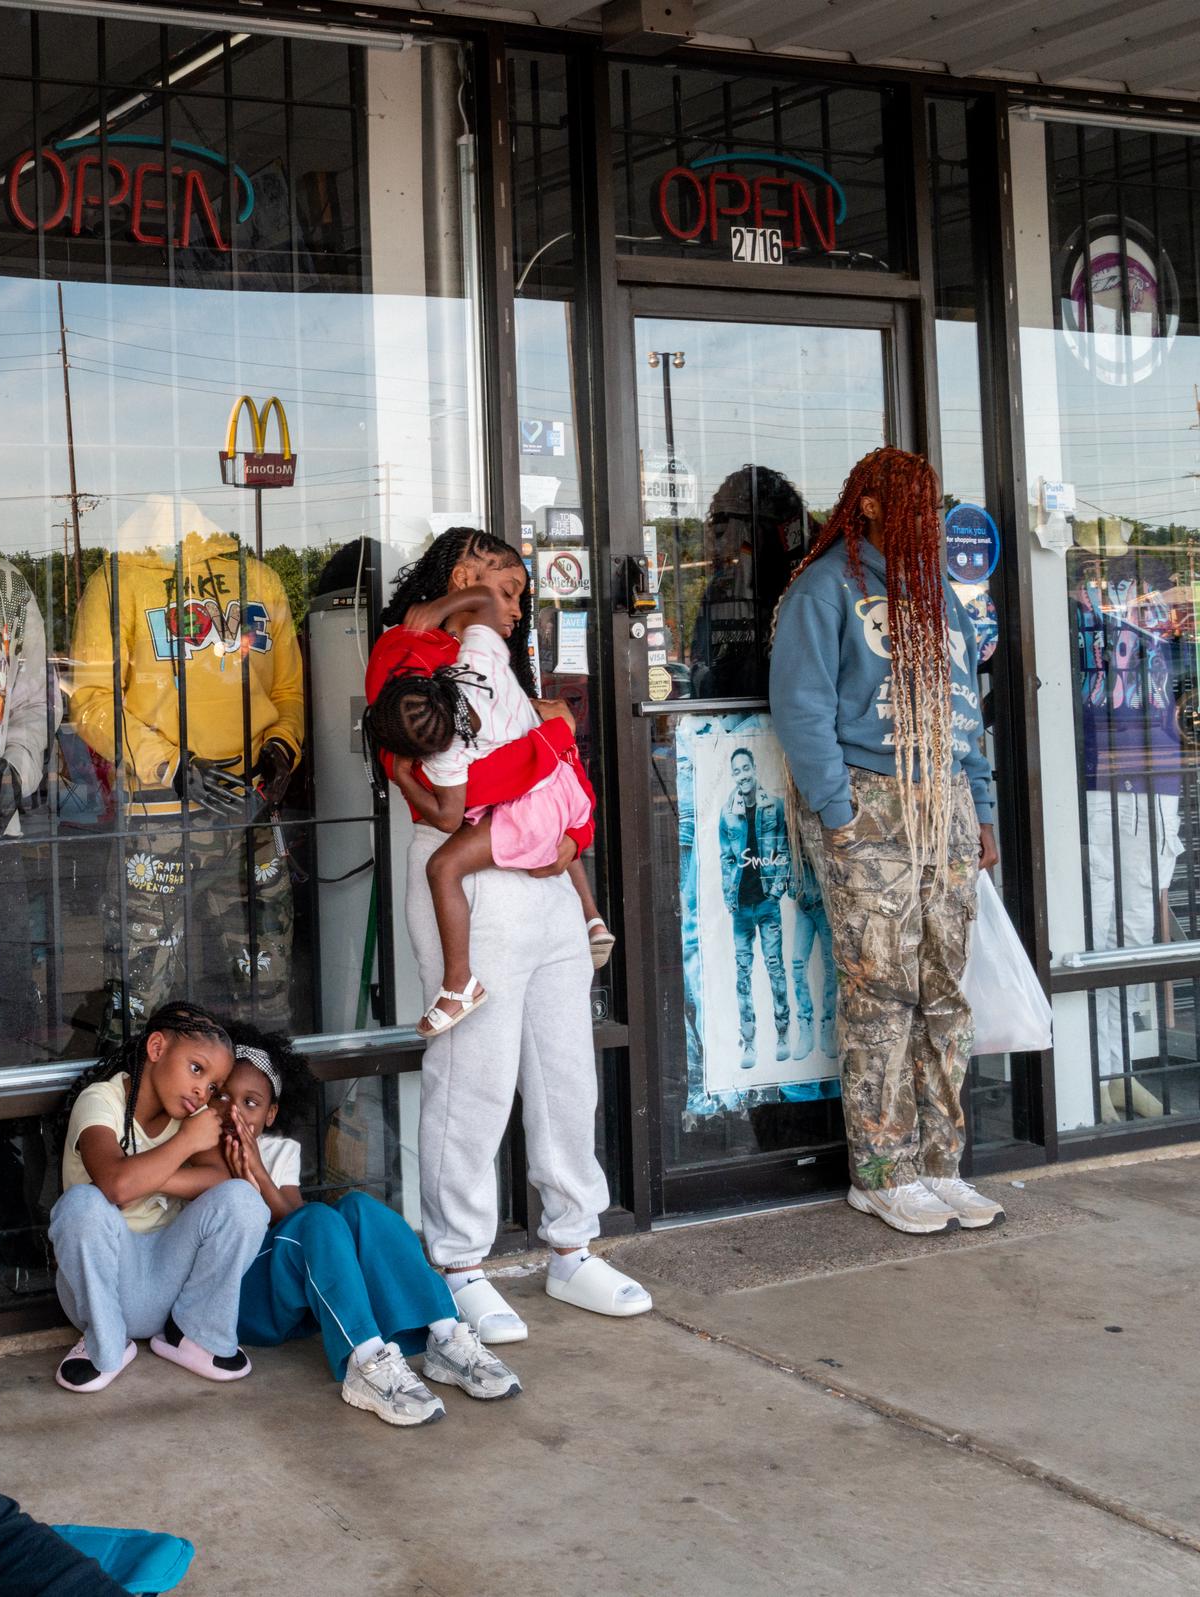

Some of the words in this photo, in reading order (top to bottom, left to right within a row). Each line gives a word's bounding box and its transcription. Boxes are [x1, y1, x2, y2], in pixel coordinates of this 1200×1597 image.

[9, 148, 238, 252] OPEN
[660, 166, 836, 251] OPEN
[732, 228, 782, 263] 2716
[1046, 484, 1064, 493] Push
[952, 525, 973, 535] Thank
[973, 528, 987, 536] you
[954, 536, 977, 545] shopping
[649, 653, 666, 662] VISA
[737, 847, 790, 870] Smoke
